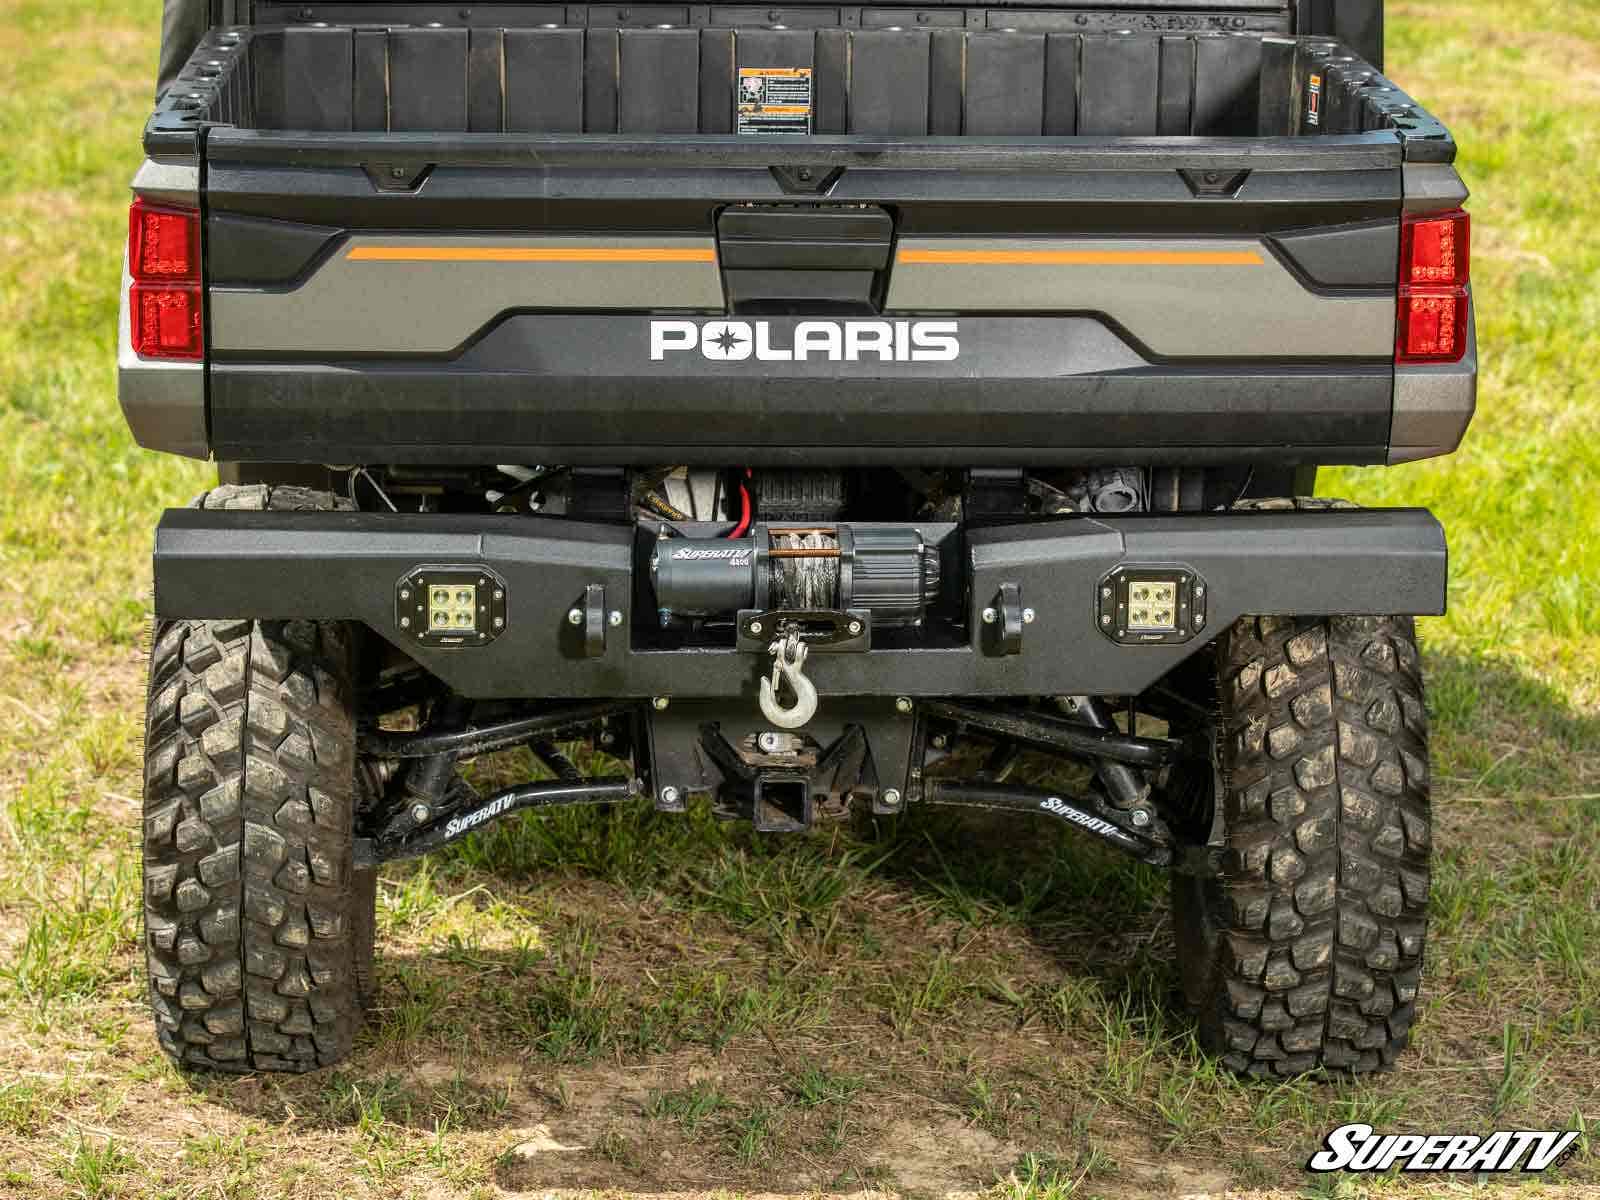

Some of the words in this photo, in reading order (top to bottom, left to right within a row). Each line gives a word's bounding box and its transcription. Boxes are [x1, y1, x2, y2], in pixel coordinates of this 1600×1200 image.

[650, 321, 960, 361] POLARIS
[672, 548, 753, 560] SUPERATV
[444, 793, 516, 839] SUPERATV
[1039, 797, 1119, 834] SUPERATV
